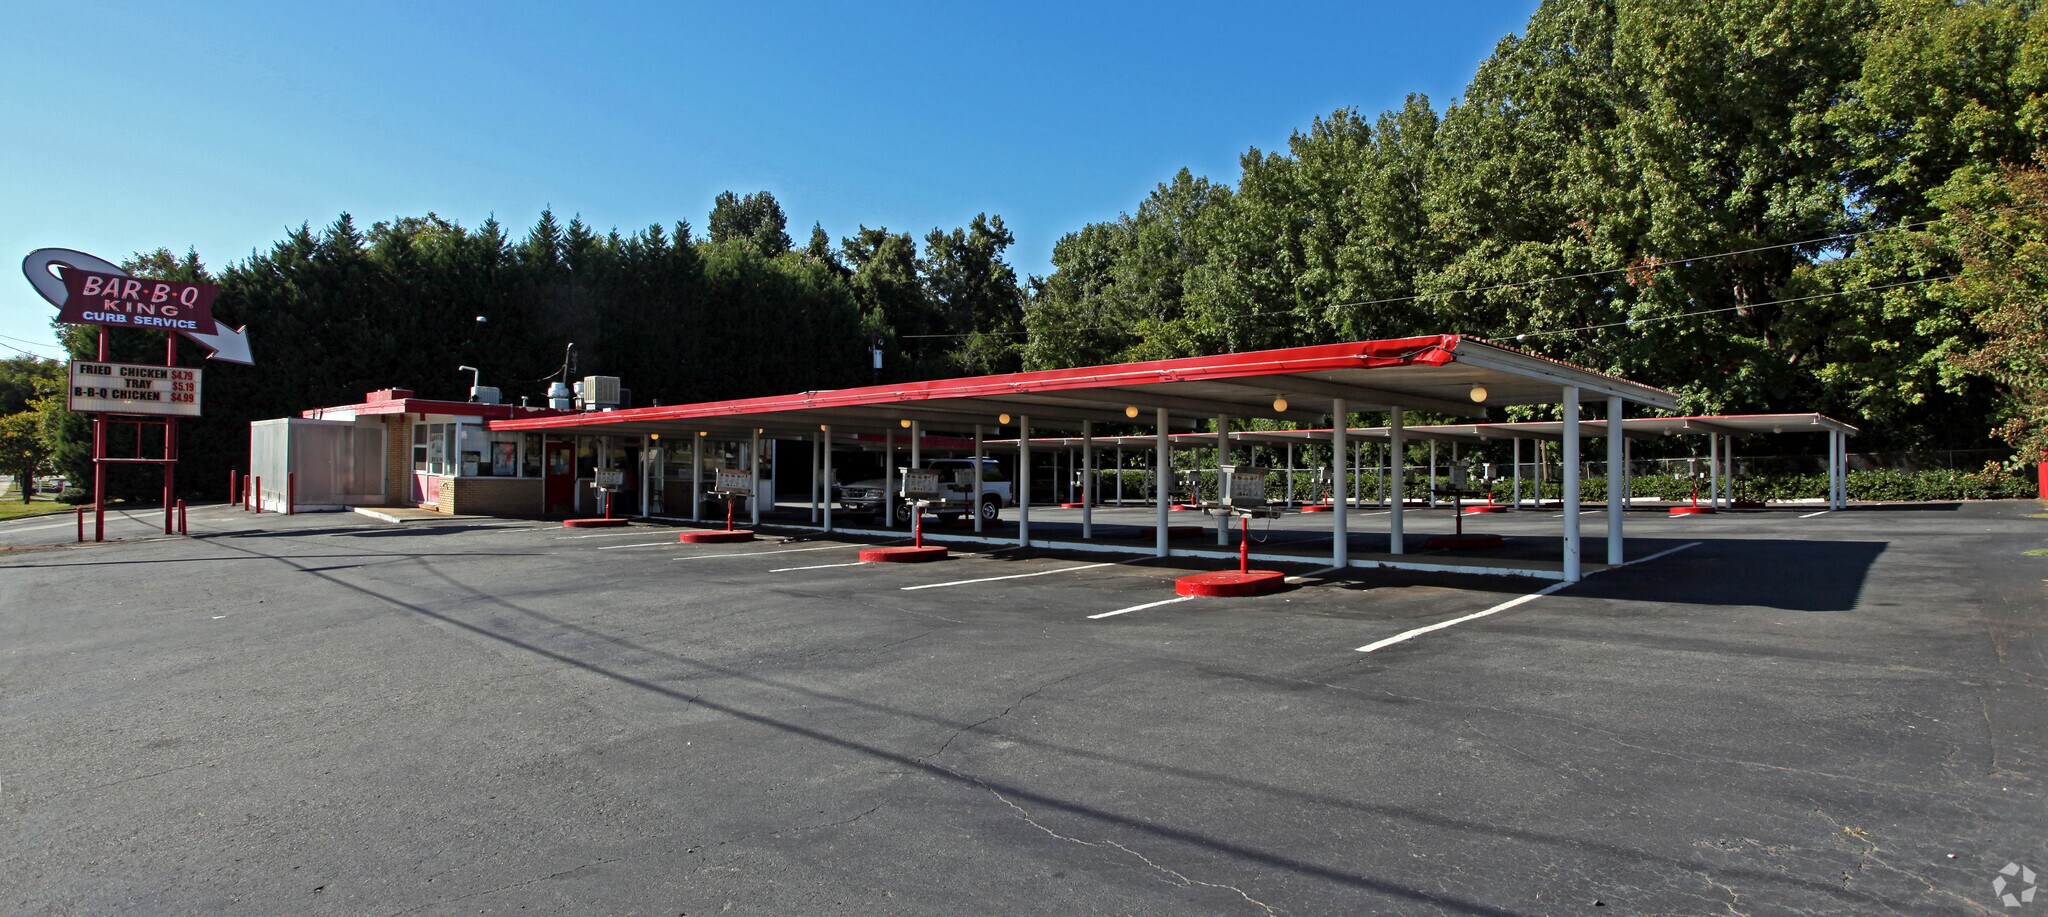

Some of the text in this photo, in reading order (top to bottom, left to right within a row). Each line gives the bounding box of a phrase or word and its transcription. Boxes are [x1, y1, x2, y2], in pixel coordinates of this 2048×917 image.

[104, 299, 179, 317] KING
[83, 311, 197, 329] CURB SERVICE
[80, 364, 193, 381] FRIED CHICKEN $4.79
[125, 378, 195, 392] TRAY $5.19
[75, 387, 194, 403] B-B-Q CHICKEN $4.99
